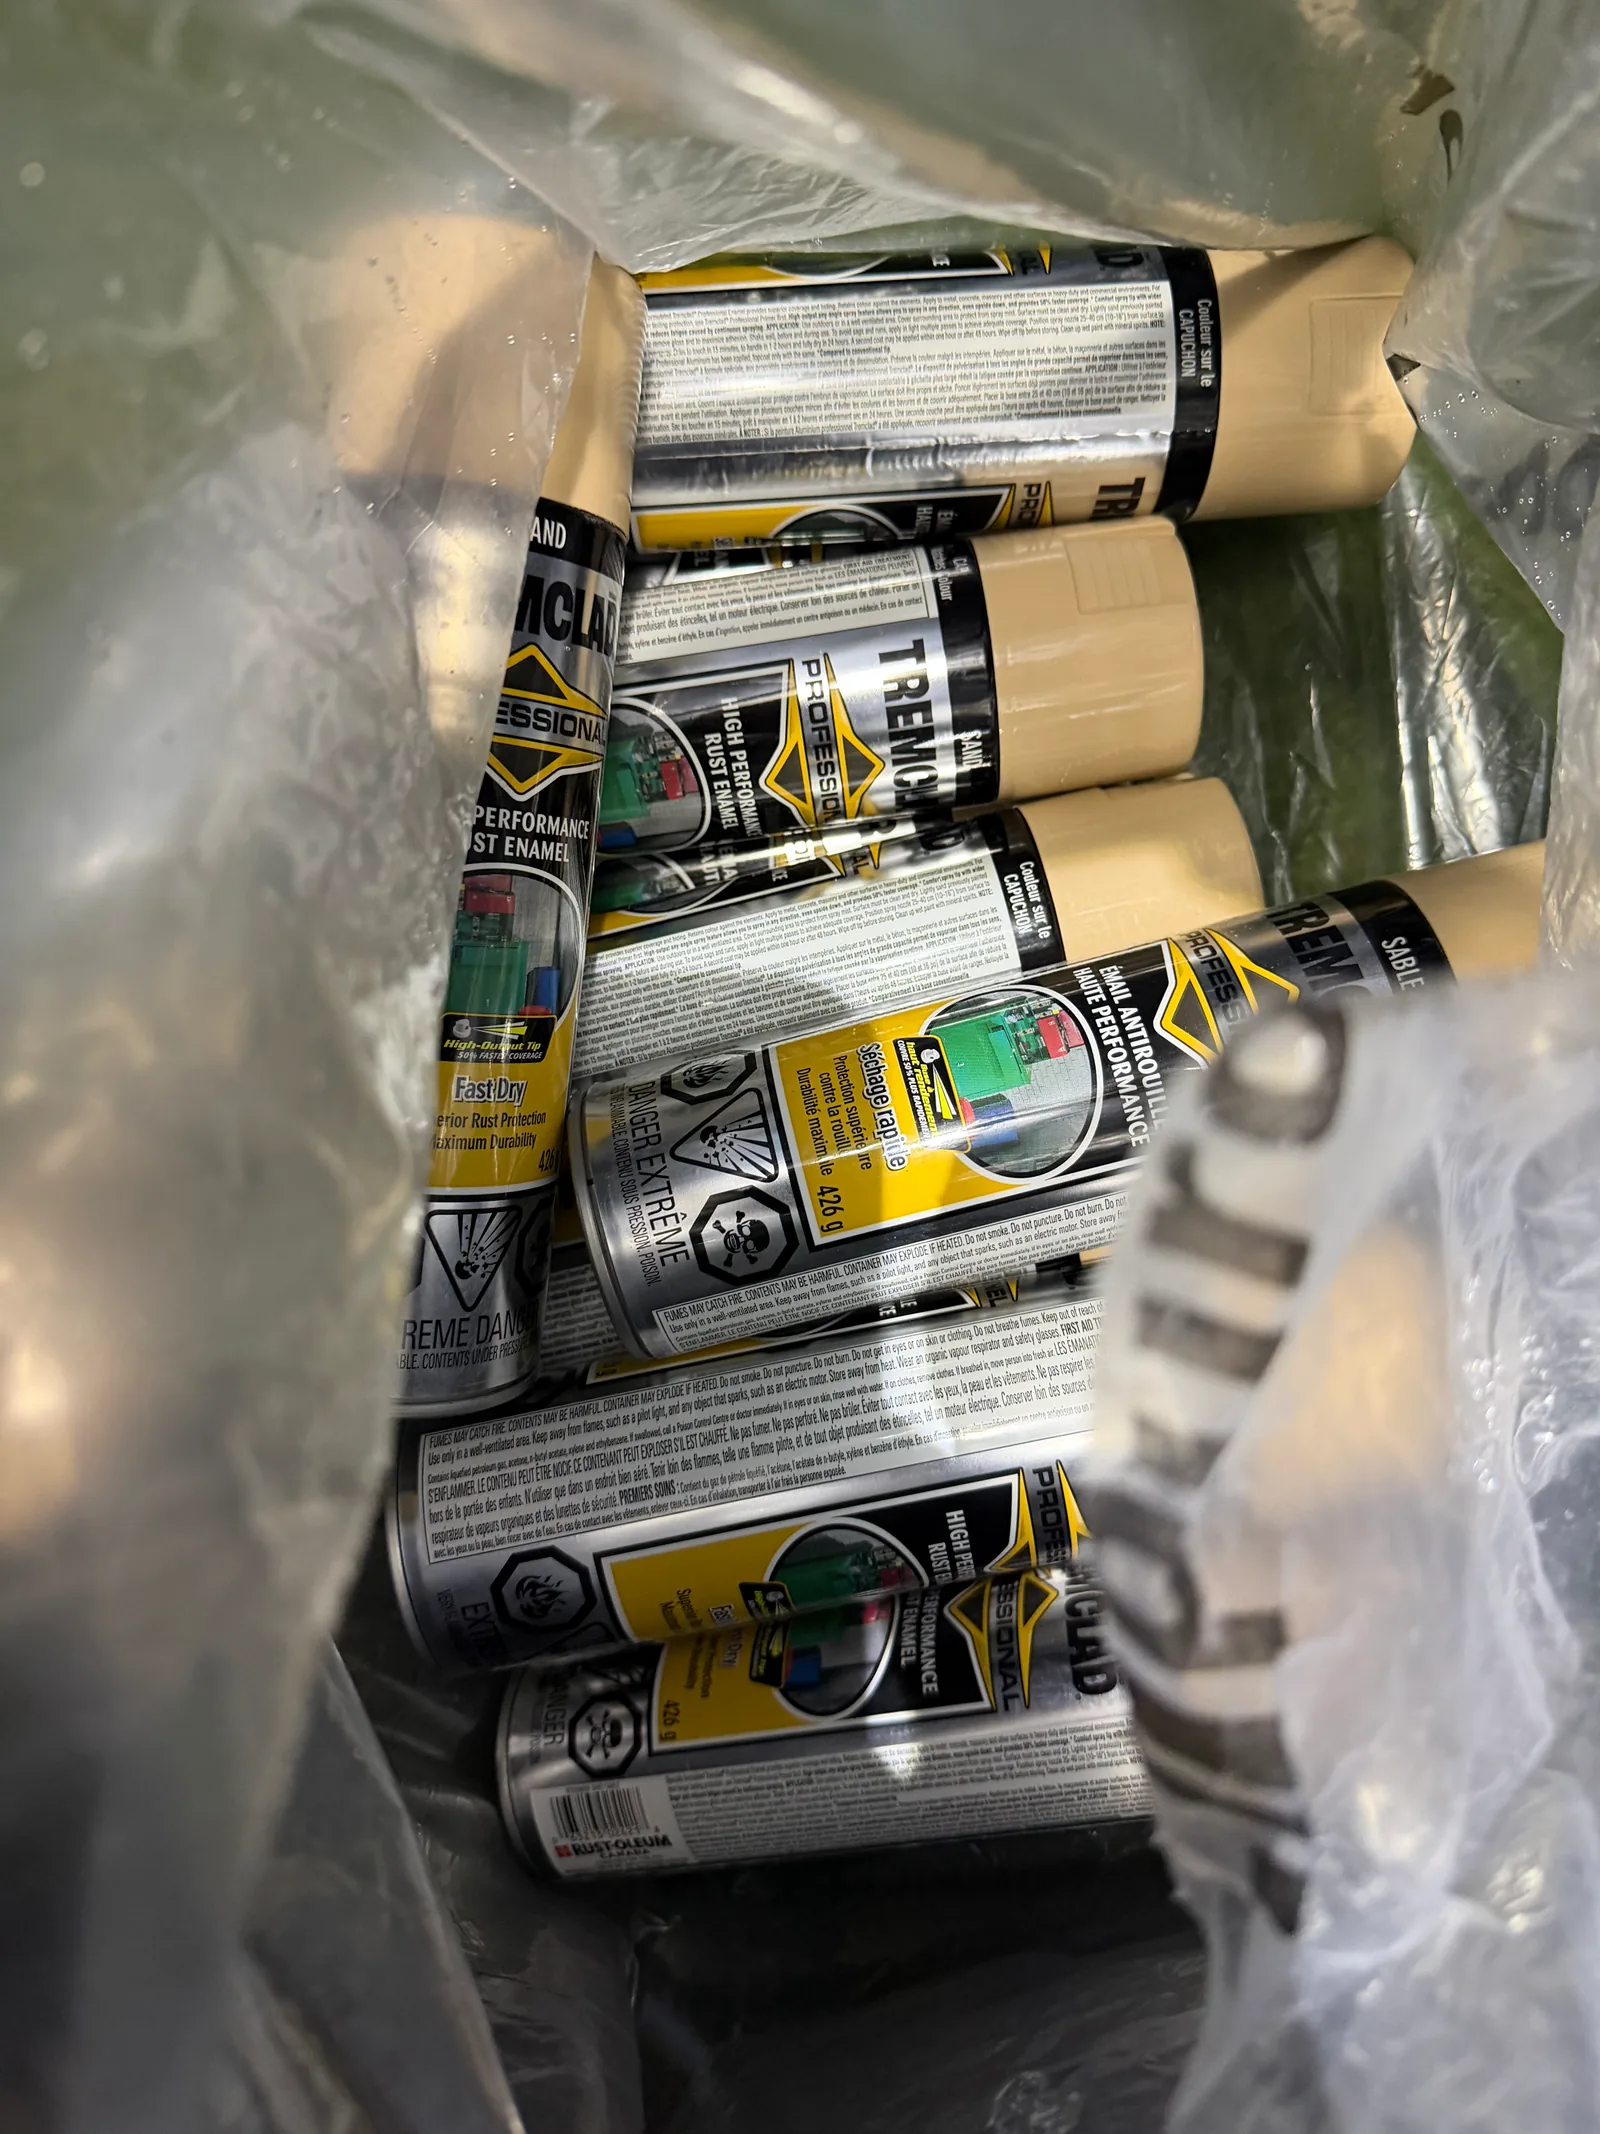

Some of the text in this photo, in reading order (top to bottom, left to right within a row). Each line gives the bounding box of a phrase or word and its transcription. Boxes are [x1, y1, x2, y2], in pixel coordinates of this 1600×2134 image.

[1179, 308, 1197, 378] CAPUCHON
[1197, 299, 1216, 388] Couleur sur le
[530, 516, 567, 549] AND
[938, 574, 953, 600] olour
[515, 574, 618, 657] MCLAD
[636, 619, 665, 636] produisant
[668, 617, 678, 628] des
[680, 613, 707, 629] étincelles,
[719, 610, 726, 621] un
[728, 607, 747, 620] moteur
[750, 601, 778, 618] électrique.
[780, 596, 808, 610] Conserver
[810, 595, 821, 606] loin
[496, 700, 607, 745] ESSIONAL
[721, 697, 745, 746] HIGH
[802, 659, 844, 822] PROFESSION
[879, 638, 938, 815] TREMCL
[704, 733, 728, 776] RUST
[961, 730, 985, 770] SAND
[473, 806, 590, 840] PERFORMANCE
[713, 780, 739, 830] ENAMEL
[467, 832, 570, 863] UST ENAMEL
[1004, 873, 1033, 935] CAPUCHON
[1020, 861, 1052, 939] Couleur sur le
[1099, 964, 1132, 1005] ÉMAIL
[1180, 930, 1249, 1024] PROFESS
[1381, 935, 1425, 991] SABLE
[457, 1052, 478, 1060] 50%
[508, 1051, 543, 1060] COVERAGE
[526, 1041, 542, 1051] Tip
[897, 1040, 910, 1062] COUVRE
[906, 1041, 920, 1066] haut
[1072, 966, 1150, 1148] HAUTE PERFORMANCE
[452, 1075, 528, 1107] Fast Dry
[819, 1071, 836, 1104] contre
[833, 1054, 856, 1103] Protection
[908, 1076, 919, 1095] PLUS
[920, 1063, 931, 1085] Buse
[437, 1111, 547, 1129] erior Rust Protection
[827, 1104, 841, 1118] la
[858, 1041, 911, 1171] Séchage rapide
[913, 1095, 931, 1138] RAPIDEMEN
[490, 1132, 537, 1150] Durability
[538, 1150, 555, 1172] 426
[613, 1138, 634, 1178] CONTENU
[797, 1067, 844, 1233] Durabilité maximle 426 g
[620, 1177, 640, 1204] SOUS
[628, 1080, 691, 1267] DANGER EXTRÊME
[625, 1203, 653, 1254] PRESSION.
[638, 1251, 662, 1287] POISON.
[664, 1235, 964, 1322] FUMES MAY CATCH FIRE. CONTENTS MAY BE HARMFUL. CONTAINER MAY EXPLODE IF HEATED.
[402, 1316, 470, 1350] REME
[422, 1350, 470, 1369] CONTENTS
[472, 1345, 498, 1365] UNDER
[499, 1337, 525, 1358] PRESS
[430, 1366, 761, 1448] FUMES MAY CATCH FIRE. CONTENTS MAY BE HARMFUL. CONTAINER MAY EXPLODE IF HEATED. Do not smoke.
[428, 1449, 622, 1503] S'ENFLAMMER. LE CONTENU PEUT ÊTRE NOCIF. CE CONTENANT
[945, 1509, 969, 1551] HIGH
[1032, 1465, 1067, 1562] PROFES
[928, 1541, 950, 1577] RUST
[900, 1606, 920, 1670] ENAMEL
[920, 1590, 940, 1696] ERFORMANCE
[995, 1582, 1020, 1711] ESSIONAL
[1064, 1575, 1118, 1694] CLAD
[544, 1682, 567, 1746] ANGER
[663, 1700, 680, 1726] 426
[571, 1834, 672, 1856] RUST-OLEUM
